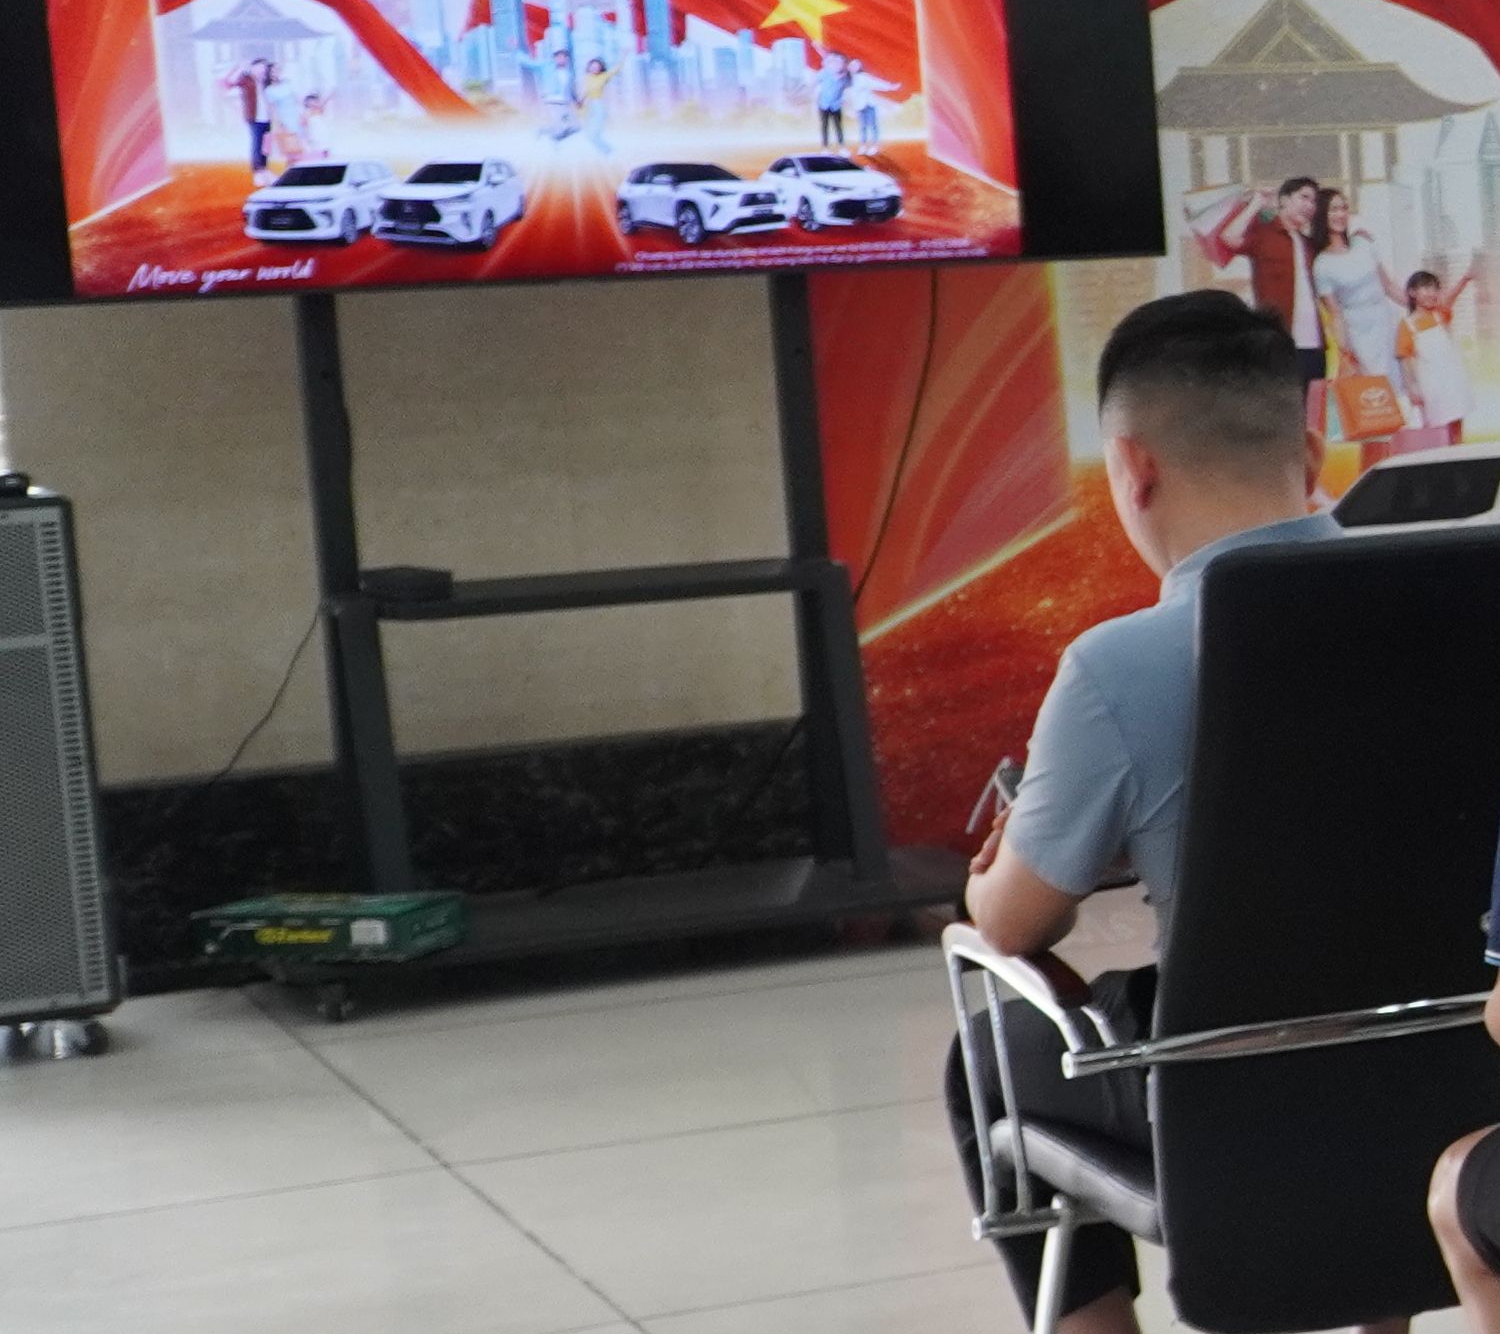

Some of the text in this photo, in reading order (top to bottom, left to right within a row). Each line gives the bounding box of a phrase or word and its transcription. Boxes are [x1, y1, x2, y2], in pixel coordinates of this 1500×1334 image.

[127, 258, 317, 294] Move your world
